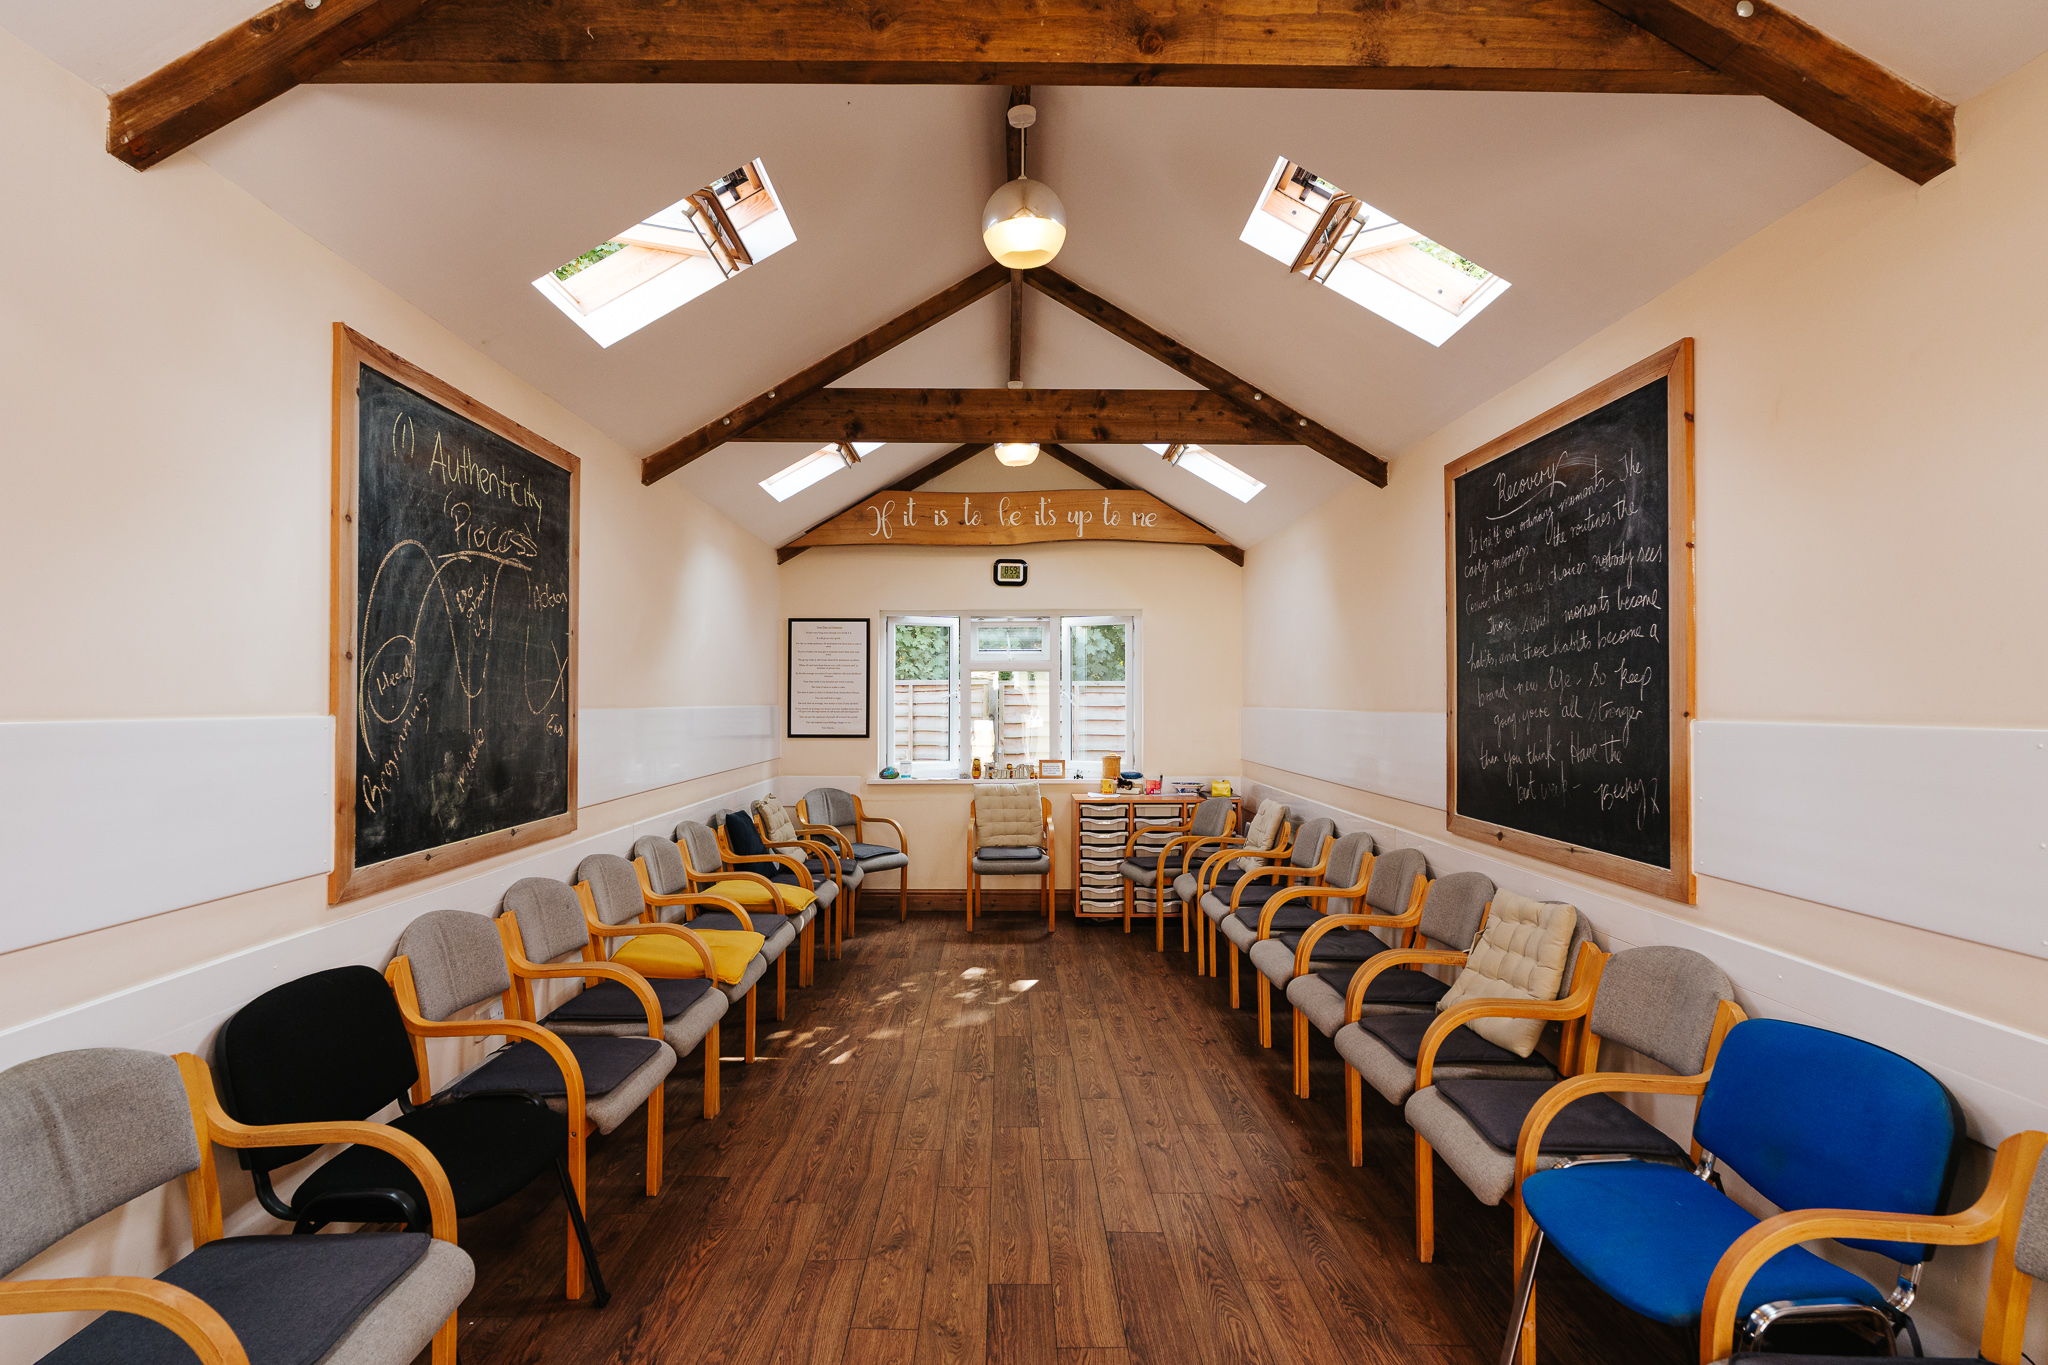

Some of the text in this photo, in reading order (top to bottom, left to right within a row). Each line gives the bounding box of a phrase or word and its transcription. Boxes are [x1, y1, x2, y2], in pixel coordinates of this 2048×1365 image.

[429, 430, 543, 534] Authenticity
[1493, 450, 1569, 509] Recovery
[1504, 525, 1517, 539] on
[1618, 447, 1644, 482] The
[866, 499, 896, 540] If
[903, 496, 919, 527] it
[934, 509, 950, 527] is
[962, 496, 982, 526] to
[998, 496, 1022, 527] be
[1034, 496, 1058, 527] it's
[1067, 509, 1093, 538] up
[1101, 496, 1122, 527] to
[1552, 521, 1568, 547] the
[1612, 493, 1640, 521] the
[1591, 540, 1635, 590] nobody
[1561, 586, 1610, 623] moments
[1617, 585, 1662, 611] become
[1597, 619, 1645, 650] become
[1649, 622, 1661, 644] a
[1477, 675, 1509, 708] brand
[1513, 680, 1538, 696] new
[1561, 694, 1584, 719] all
[1503, 750, 1522, 787] you
[1526, 724, 1556, 768] think
[1569, 729, 1600, 764] Have
[1593, 777, 1647, 831] Becky
